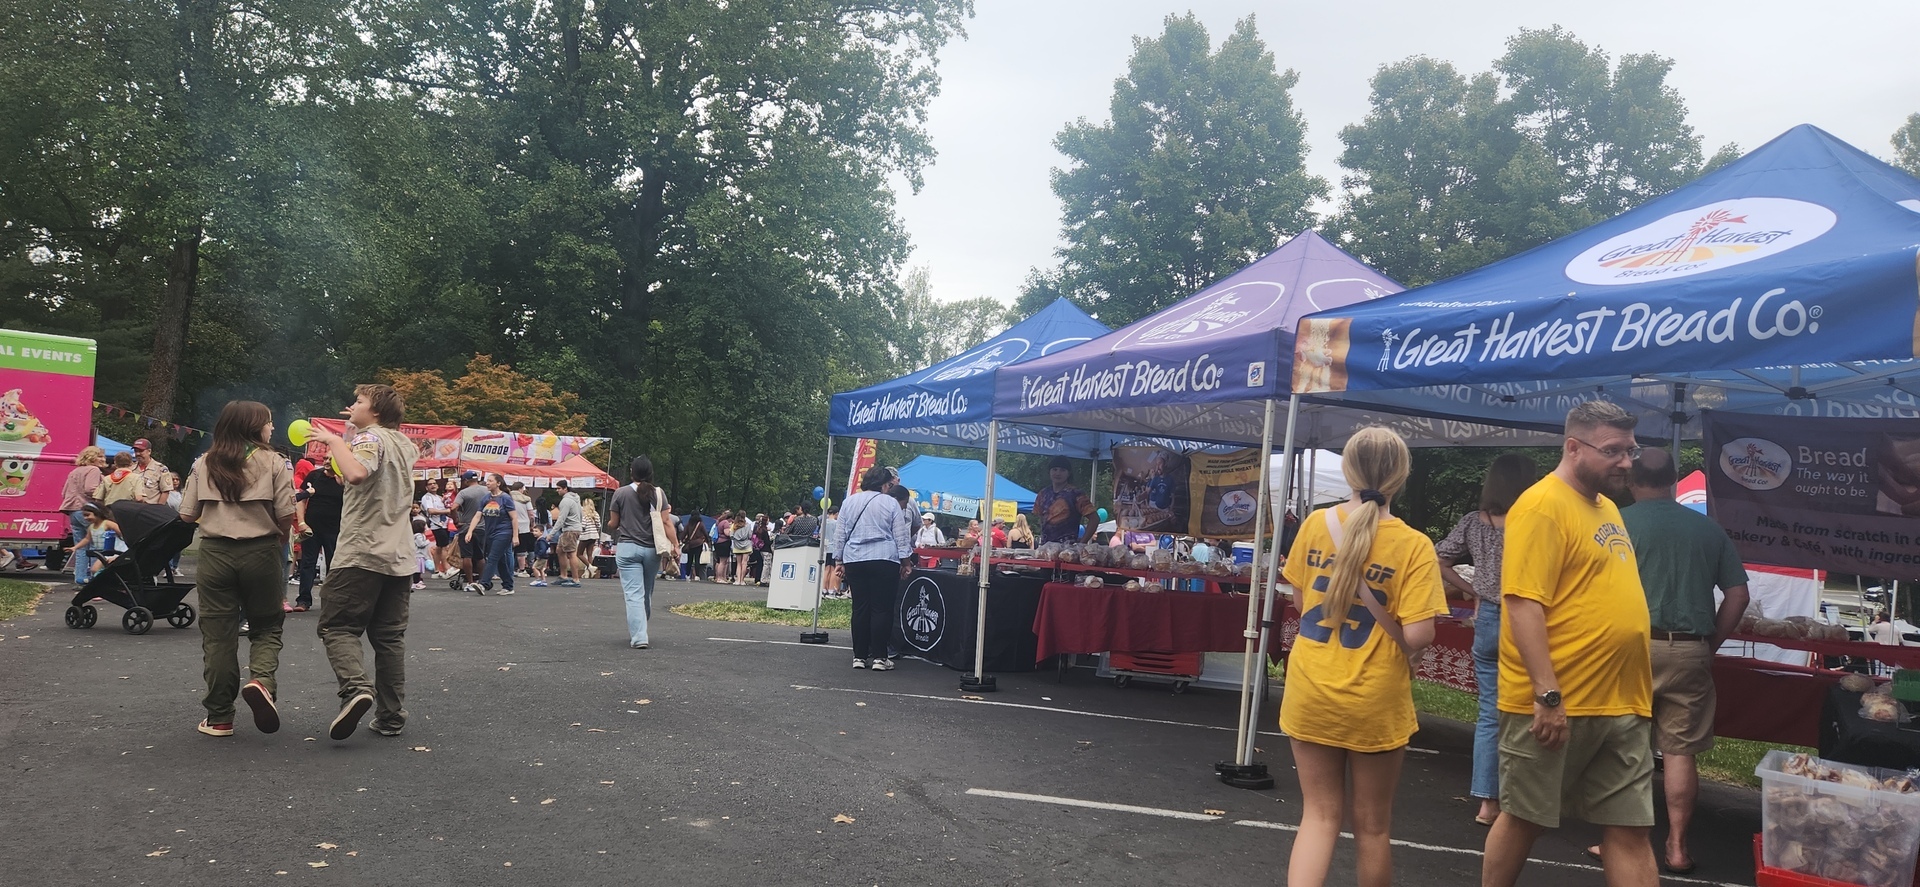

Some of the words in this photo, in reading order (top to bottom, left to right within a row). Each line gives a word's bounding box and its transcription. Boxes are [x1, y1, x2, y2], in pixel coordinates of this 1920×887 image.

[1597, 232, 1686, 262] Great
[1696, 227, 1793, 245] Harvest
[1614, 266, 1670, 278] Bread
[1392, 327, 1481, 369] Great
[1479, 306, 1616, 364] Harvest
[1611, 297, 1743, 352] Bread
[21, 346, 82, 363] EVENTS
[1028, 371, 1069, 409] Great
[1068, 361, 1134, 402] Harvest
[1130, 359, 1191, 397] Bread
[851, 398, 881, 426] Great
[878, 392, 919, 422] Harvest
[915, 390, 950, 418] Bread
[464, 442, 509, 456] lemonade
[1797, 445, 1868, 467] Bread
[1728, 455, 1750, 466] Great
[1754, 456, 1781, 474] Harvest
[1796, 467, 1821, 481] The
[1826, 471, 1854, 484] way
[1859, 471, 1869, 483] it
[1795, 483, 1831, 496] ought
[1834, 486, 1847, 496] to
[1850, 485, 1868, 498] be.
[953, 503, 974, 513] Cake
[10, 522, 18, 530] A
[13, 518, 58, 534] Treat
[1756, 515, 1789, 532] Made
[1792, 522, 1829, 537] from
[1834, 527, 1890, 544] scratch
[1895, 531, 1909, 544] in
[1725, 528, 1775, 547] Bakery
[1780, 534, 1790, 547] &
[1830, 545, 1864, 558] with
[1307, 549, 1336, 570] CLA
[1365, 563, 1396, 584] OF
[1299, 575, 1389, 650] 25
